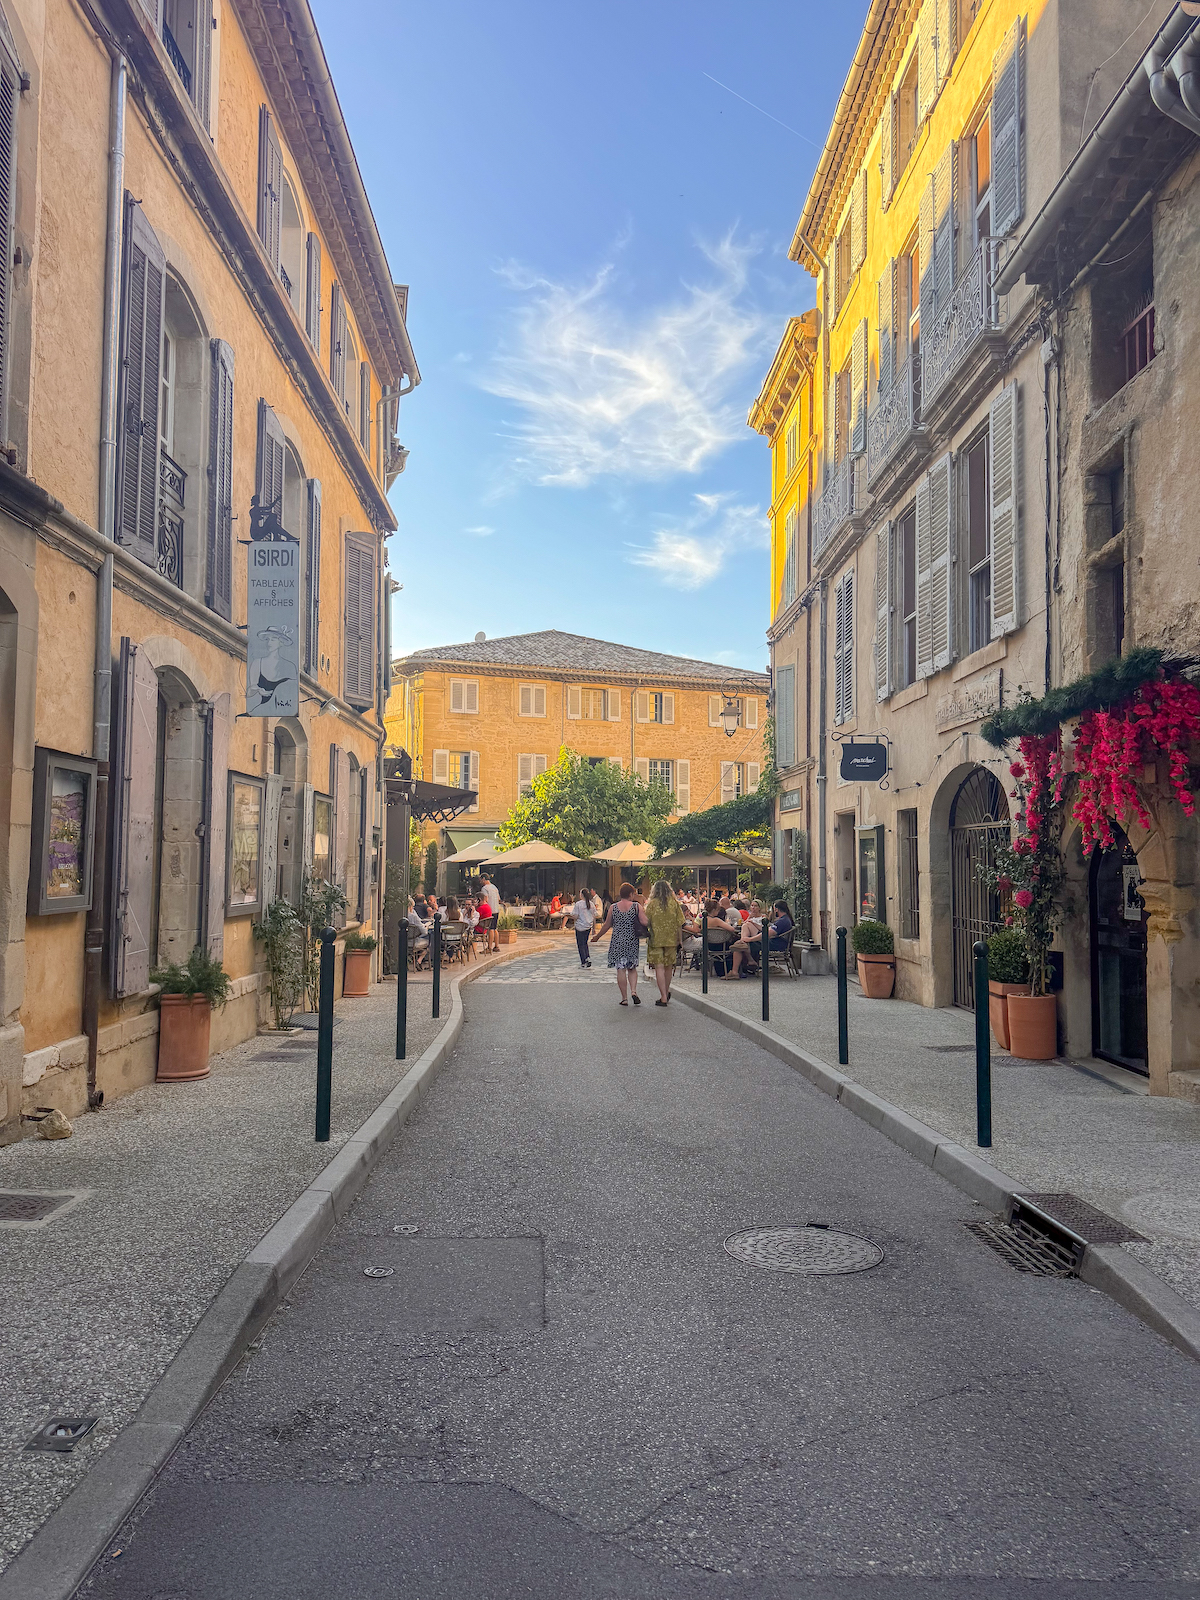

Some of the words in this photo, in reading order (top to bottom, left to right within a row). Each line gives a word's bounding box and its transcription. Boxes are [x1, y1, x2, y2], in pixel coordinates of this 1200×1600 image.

[254, 549, 294, 566] ISIRDI
[251, 579, 295, 588] TABLEAUX
[253, 598, 294, 607] AFFICHES
